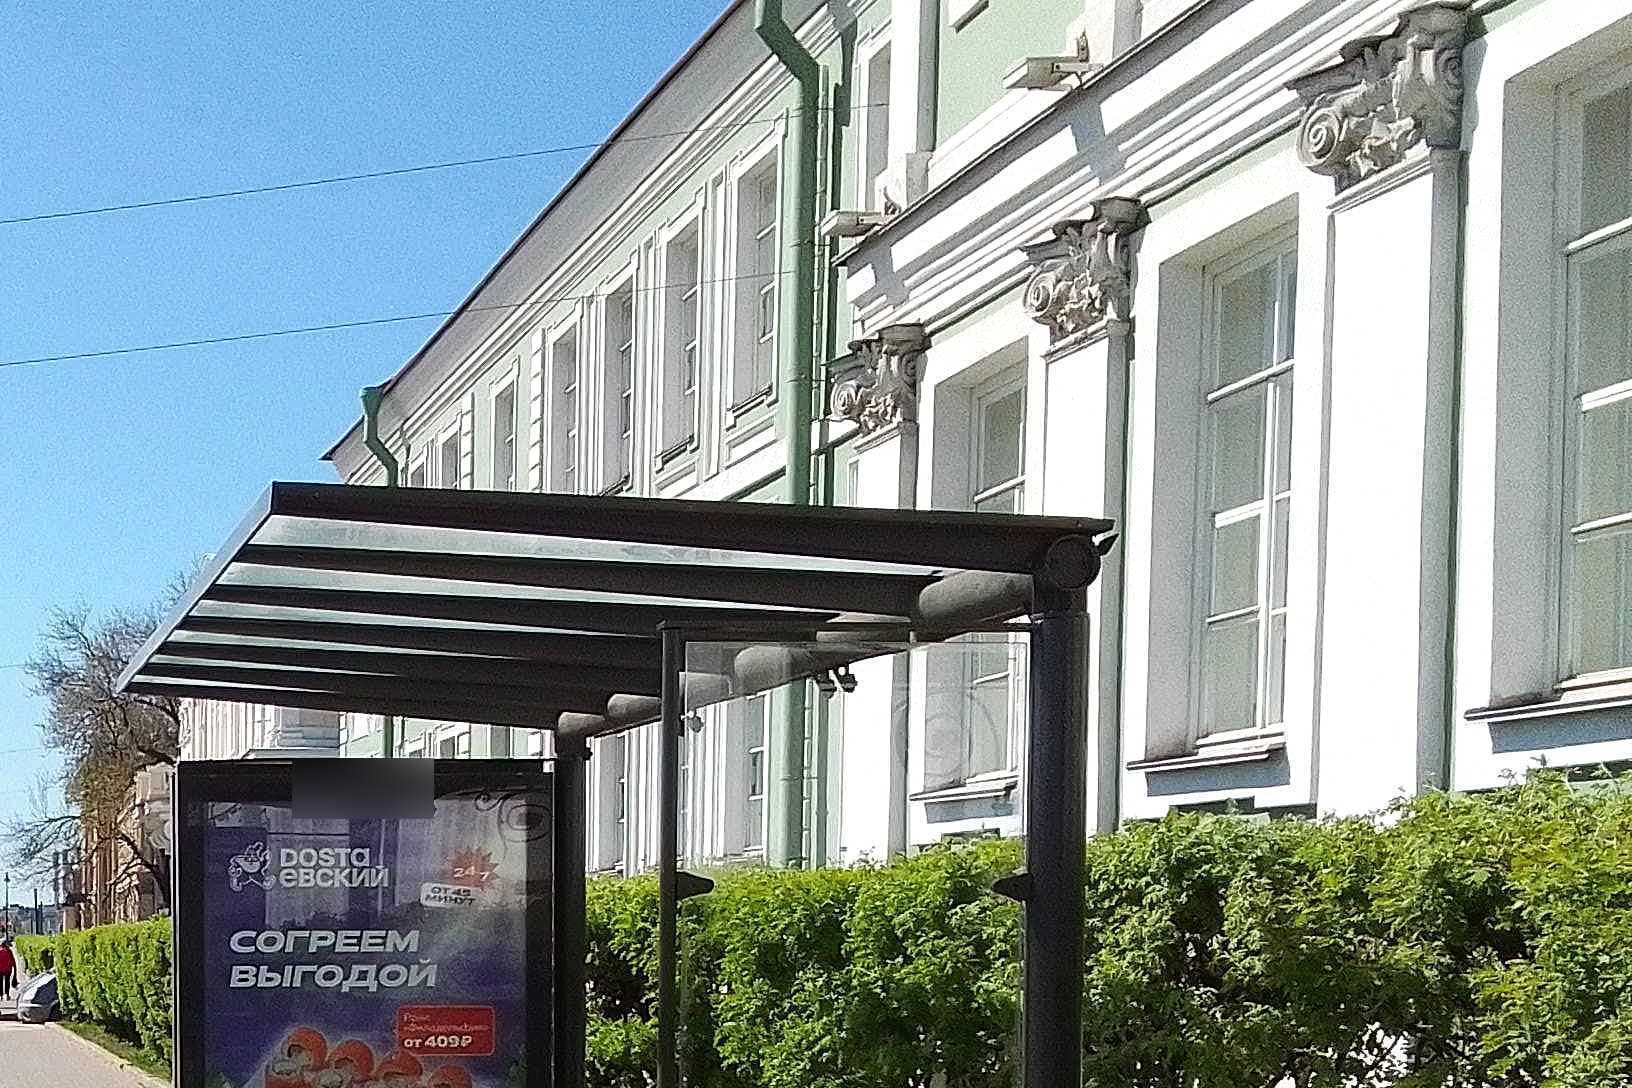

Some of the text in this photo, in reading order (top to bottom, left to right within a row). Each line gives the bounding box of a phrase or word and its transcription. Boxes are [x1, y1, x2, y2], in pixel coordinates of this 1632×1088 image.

[229, 930, 419, 953] СОГРЕЕМ
[229, 959, 438, 992] ВЫГОДОЙ
[403, 1038, 422, 1048] от
